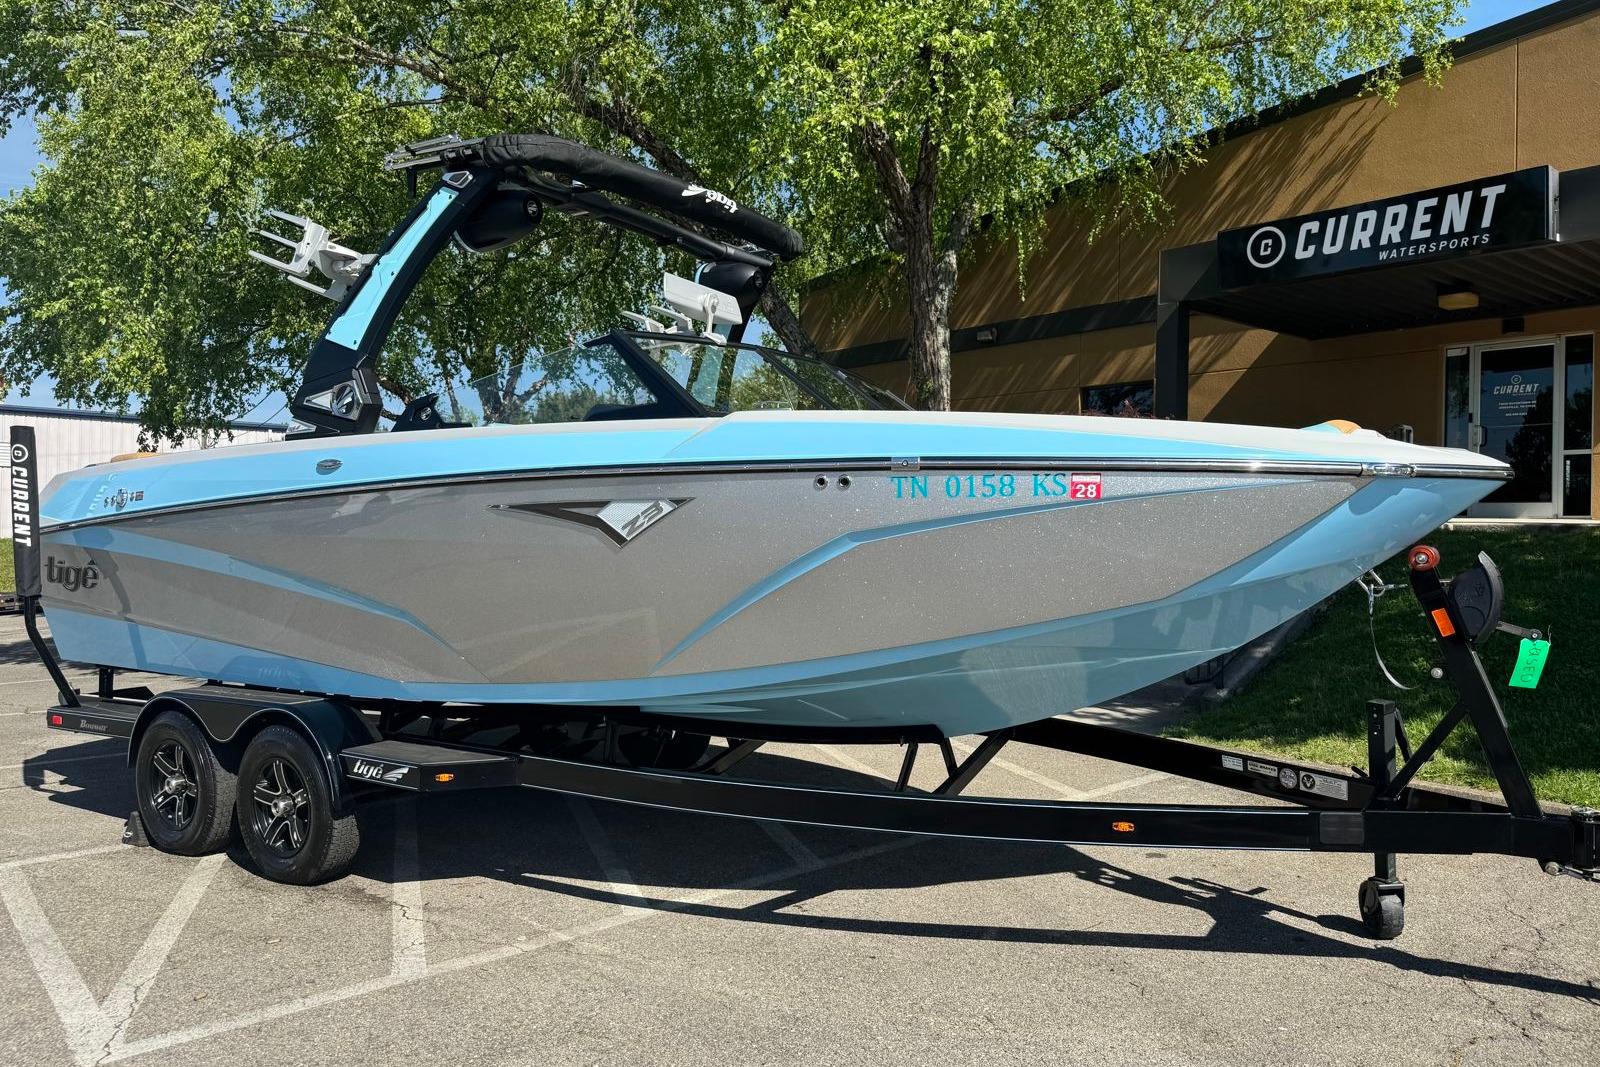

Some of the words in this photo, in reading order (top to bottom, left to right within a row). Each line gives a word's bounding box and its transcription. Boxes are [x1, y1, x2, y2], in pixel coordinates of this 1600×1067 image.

[1294, 184, 1507, 260] CURRENT
[1379, 233, 1491, 261] WATERSPORTS
[1493, 384, 1540, 395] CURRENT
[890, 475, 929, 499] TN
[945, 473, 1016, 498] 0158
[1032, 473, 1069, 497] KS
[1075, 484, 1097, 498] 28
[12, 466, 32, 548] CURRENT
